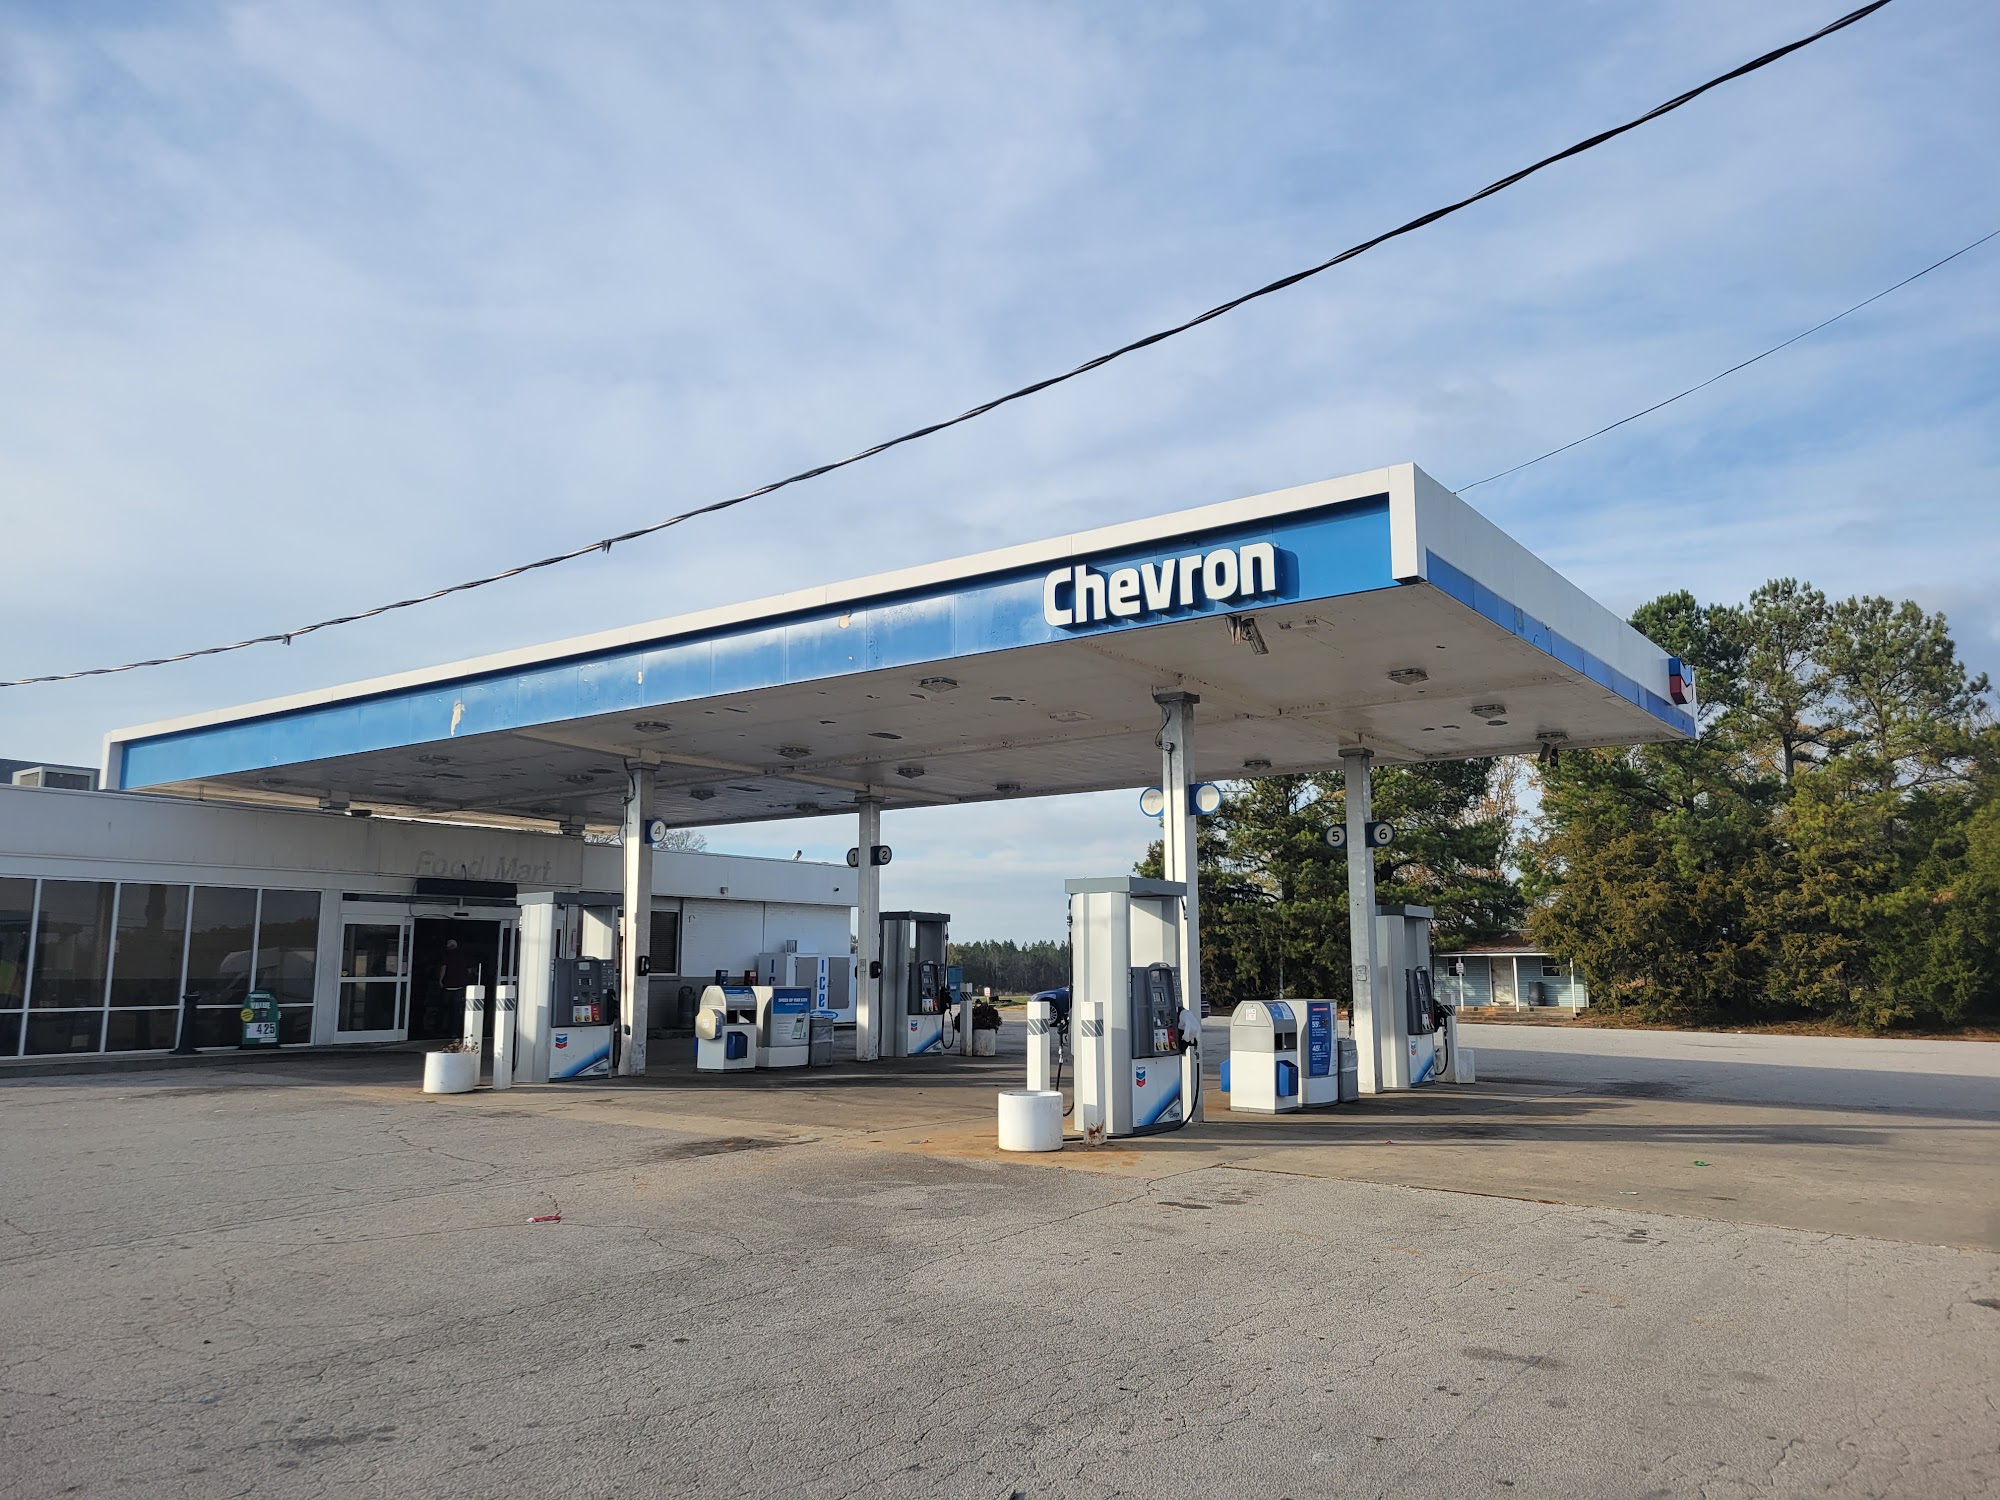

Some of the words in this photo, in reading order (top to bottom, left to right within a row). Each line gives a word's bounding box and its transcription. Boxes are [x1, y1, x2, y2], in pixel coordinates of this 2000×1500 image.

[1043, 542, 1276, 626] Chevron
[654, 825, 662, 834] 4
[1379, 828, 1388, 840] 6
[1332, 831, 1340, 842] 5
[882, 850, 888, 860] 2
[495, 856, 552, 881] Mart
